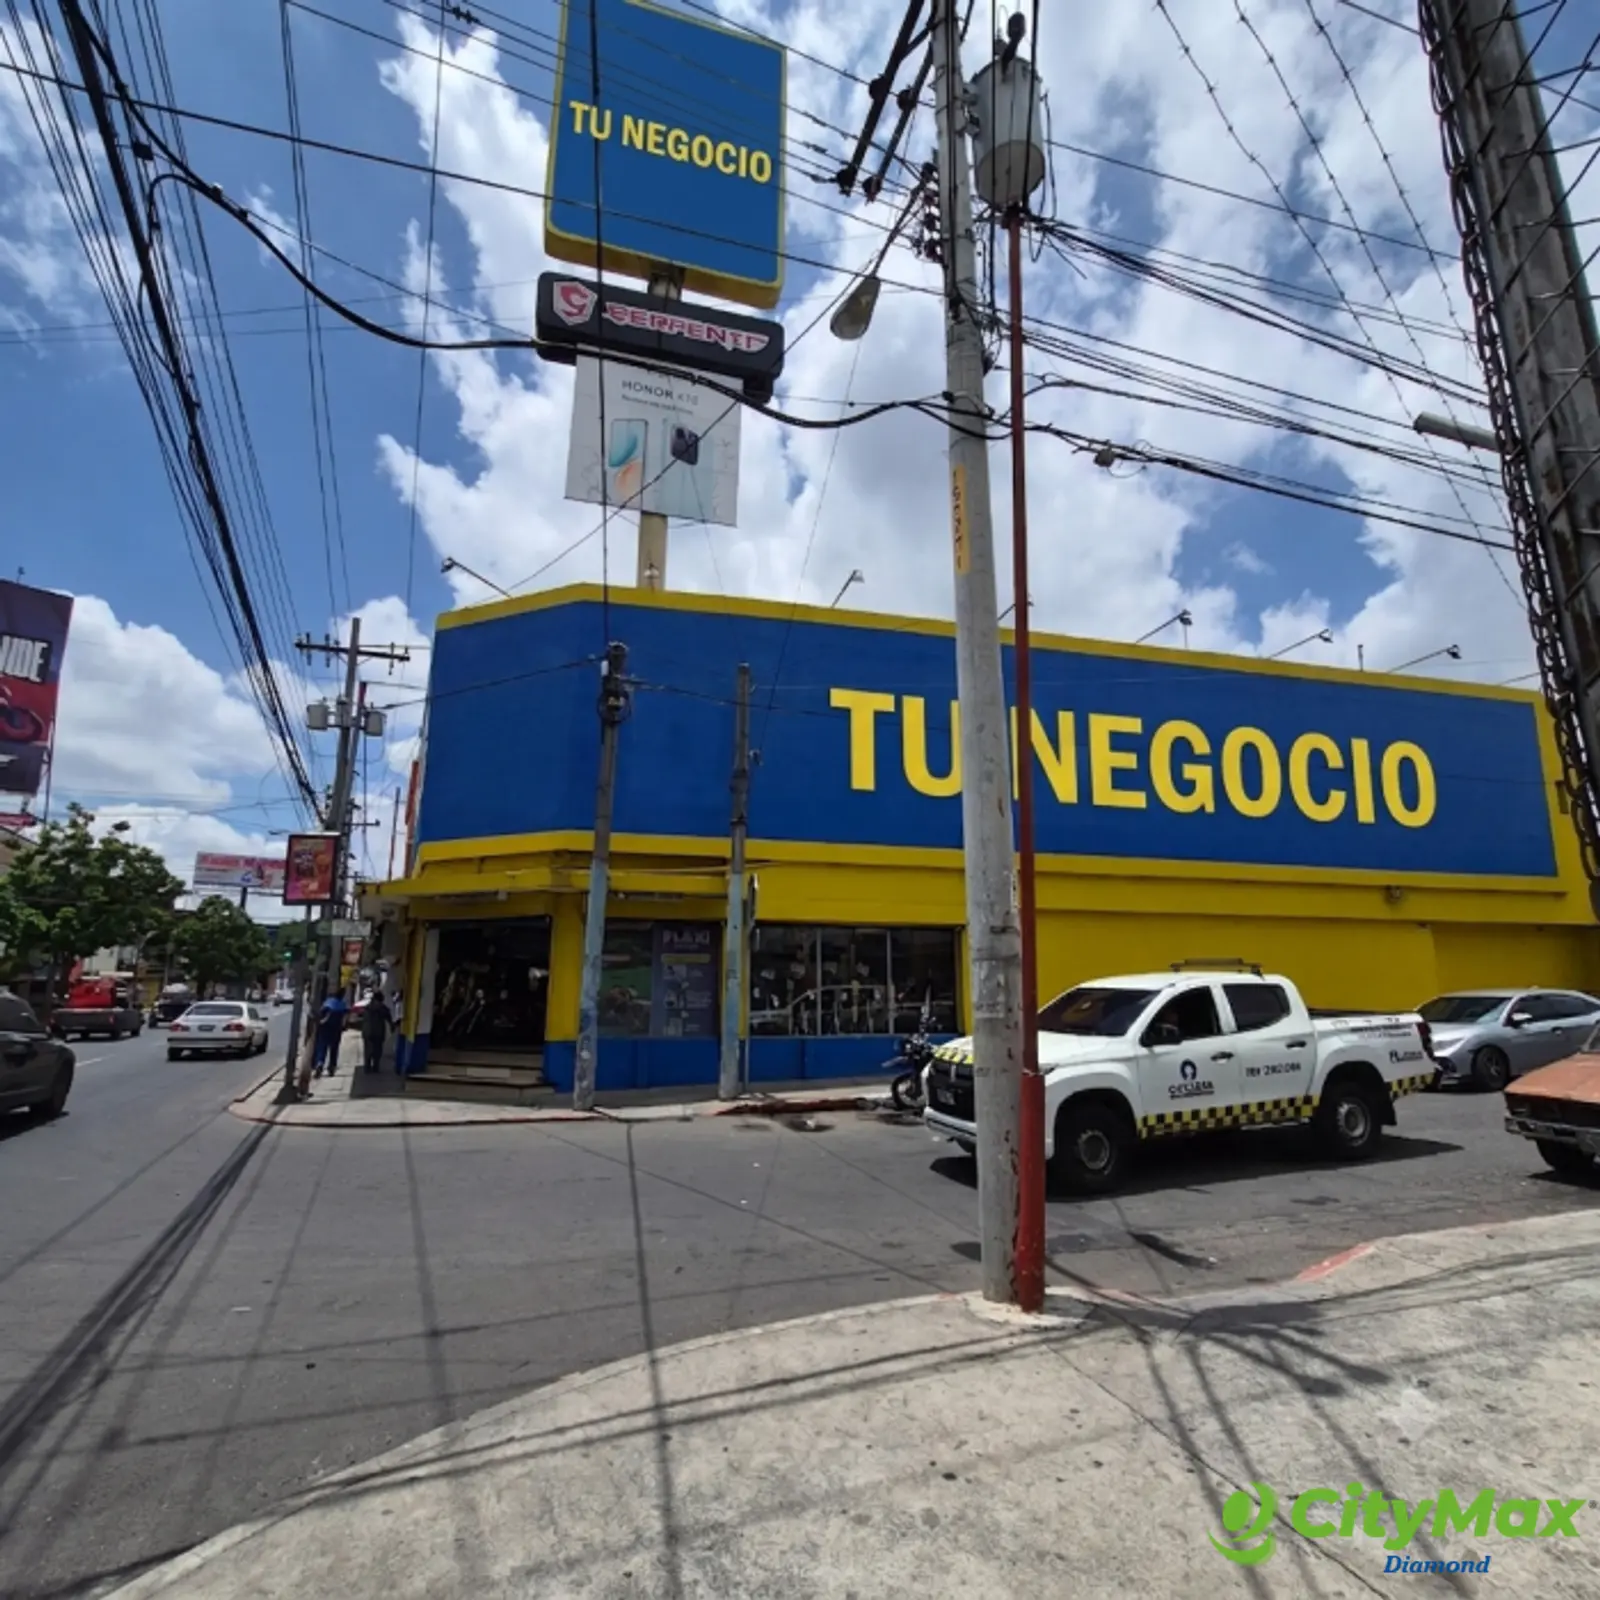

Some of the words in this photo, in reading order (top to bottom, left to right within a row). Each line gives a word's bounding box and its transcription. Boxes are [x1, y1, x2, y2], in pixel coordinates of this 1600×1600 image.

[569, 100, 612, 141] TU
[621, 114, 772, 183] NEGOCIO
[621, 380, 674, 400] HONOR
[829, 687, 963, 797] TU
[1010, 706, 1438, 829] NEGOCIO
